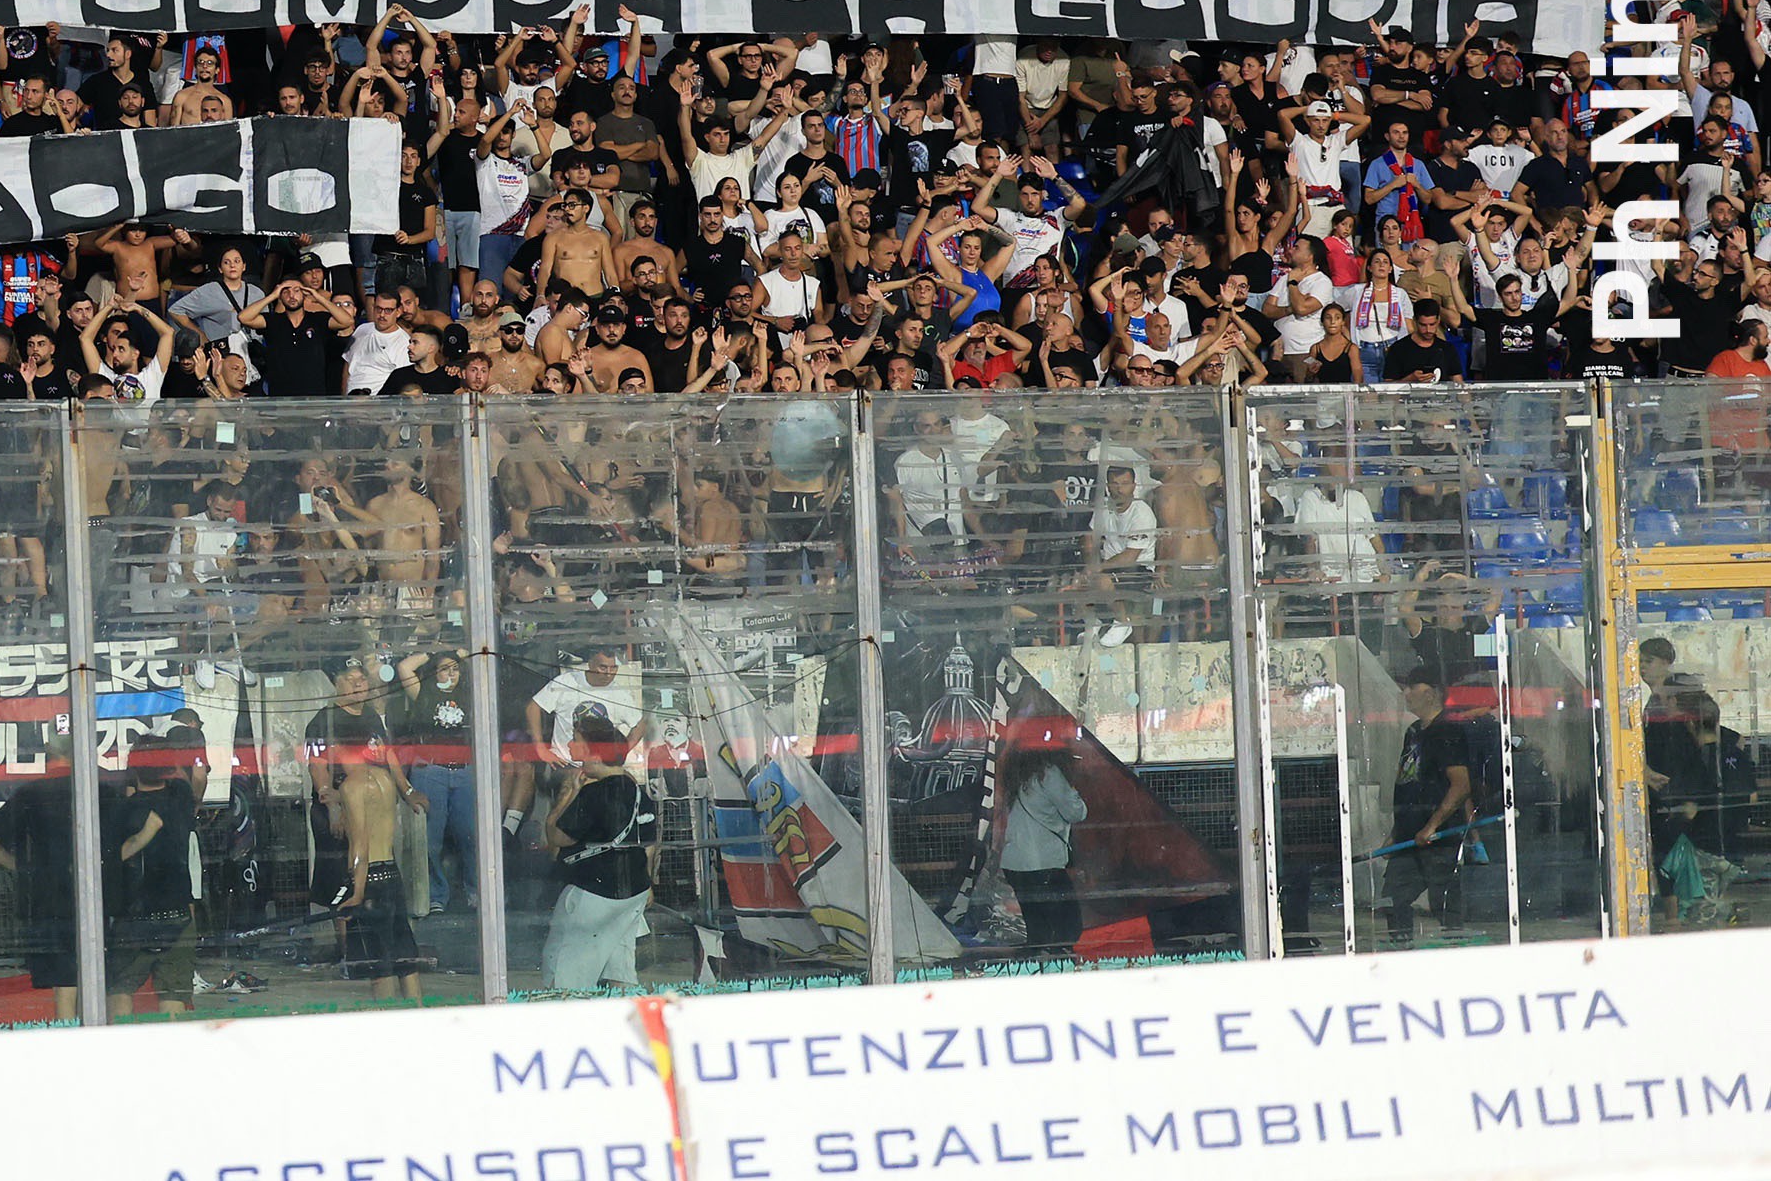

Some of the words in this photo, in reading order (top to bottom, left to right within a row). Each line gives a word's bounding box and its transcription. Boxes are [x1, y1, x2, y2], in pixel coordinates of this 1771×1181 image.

[1484, 154, 1516, 167] ICON
[492, 1015, 1176, 1095] MANUTENZIONE
[1216, 1011, 1259, 1054] E
[1290, 989, 1629, 1048] VENDITA
[728, 1137, 771, 1181] E
[814, 1116, 1086, 1174] SCALE
[1125, 1096, 1404, 1156] MOBILI
[1470, 1073, 1771, 1132] MULTIM
